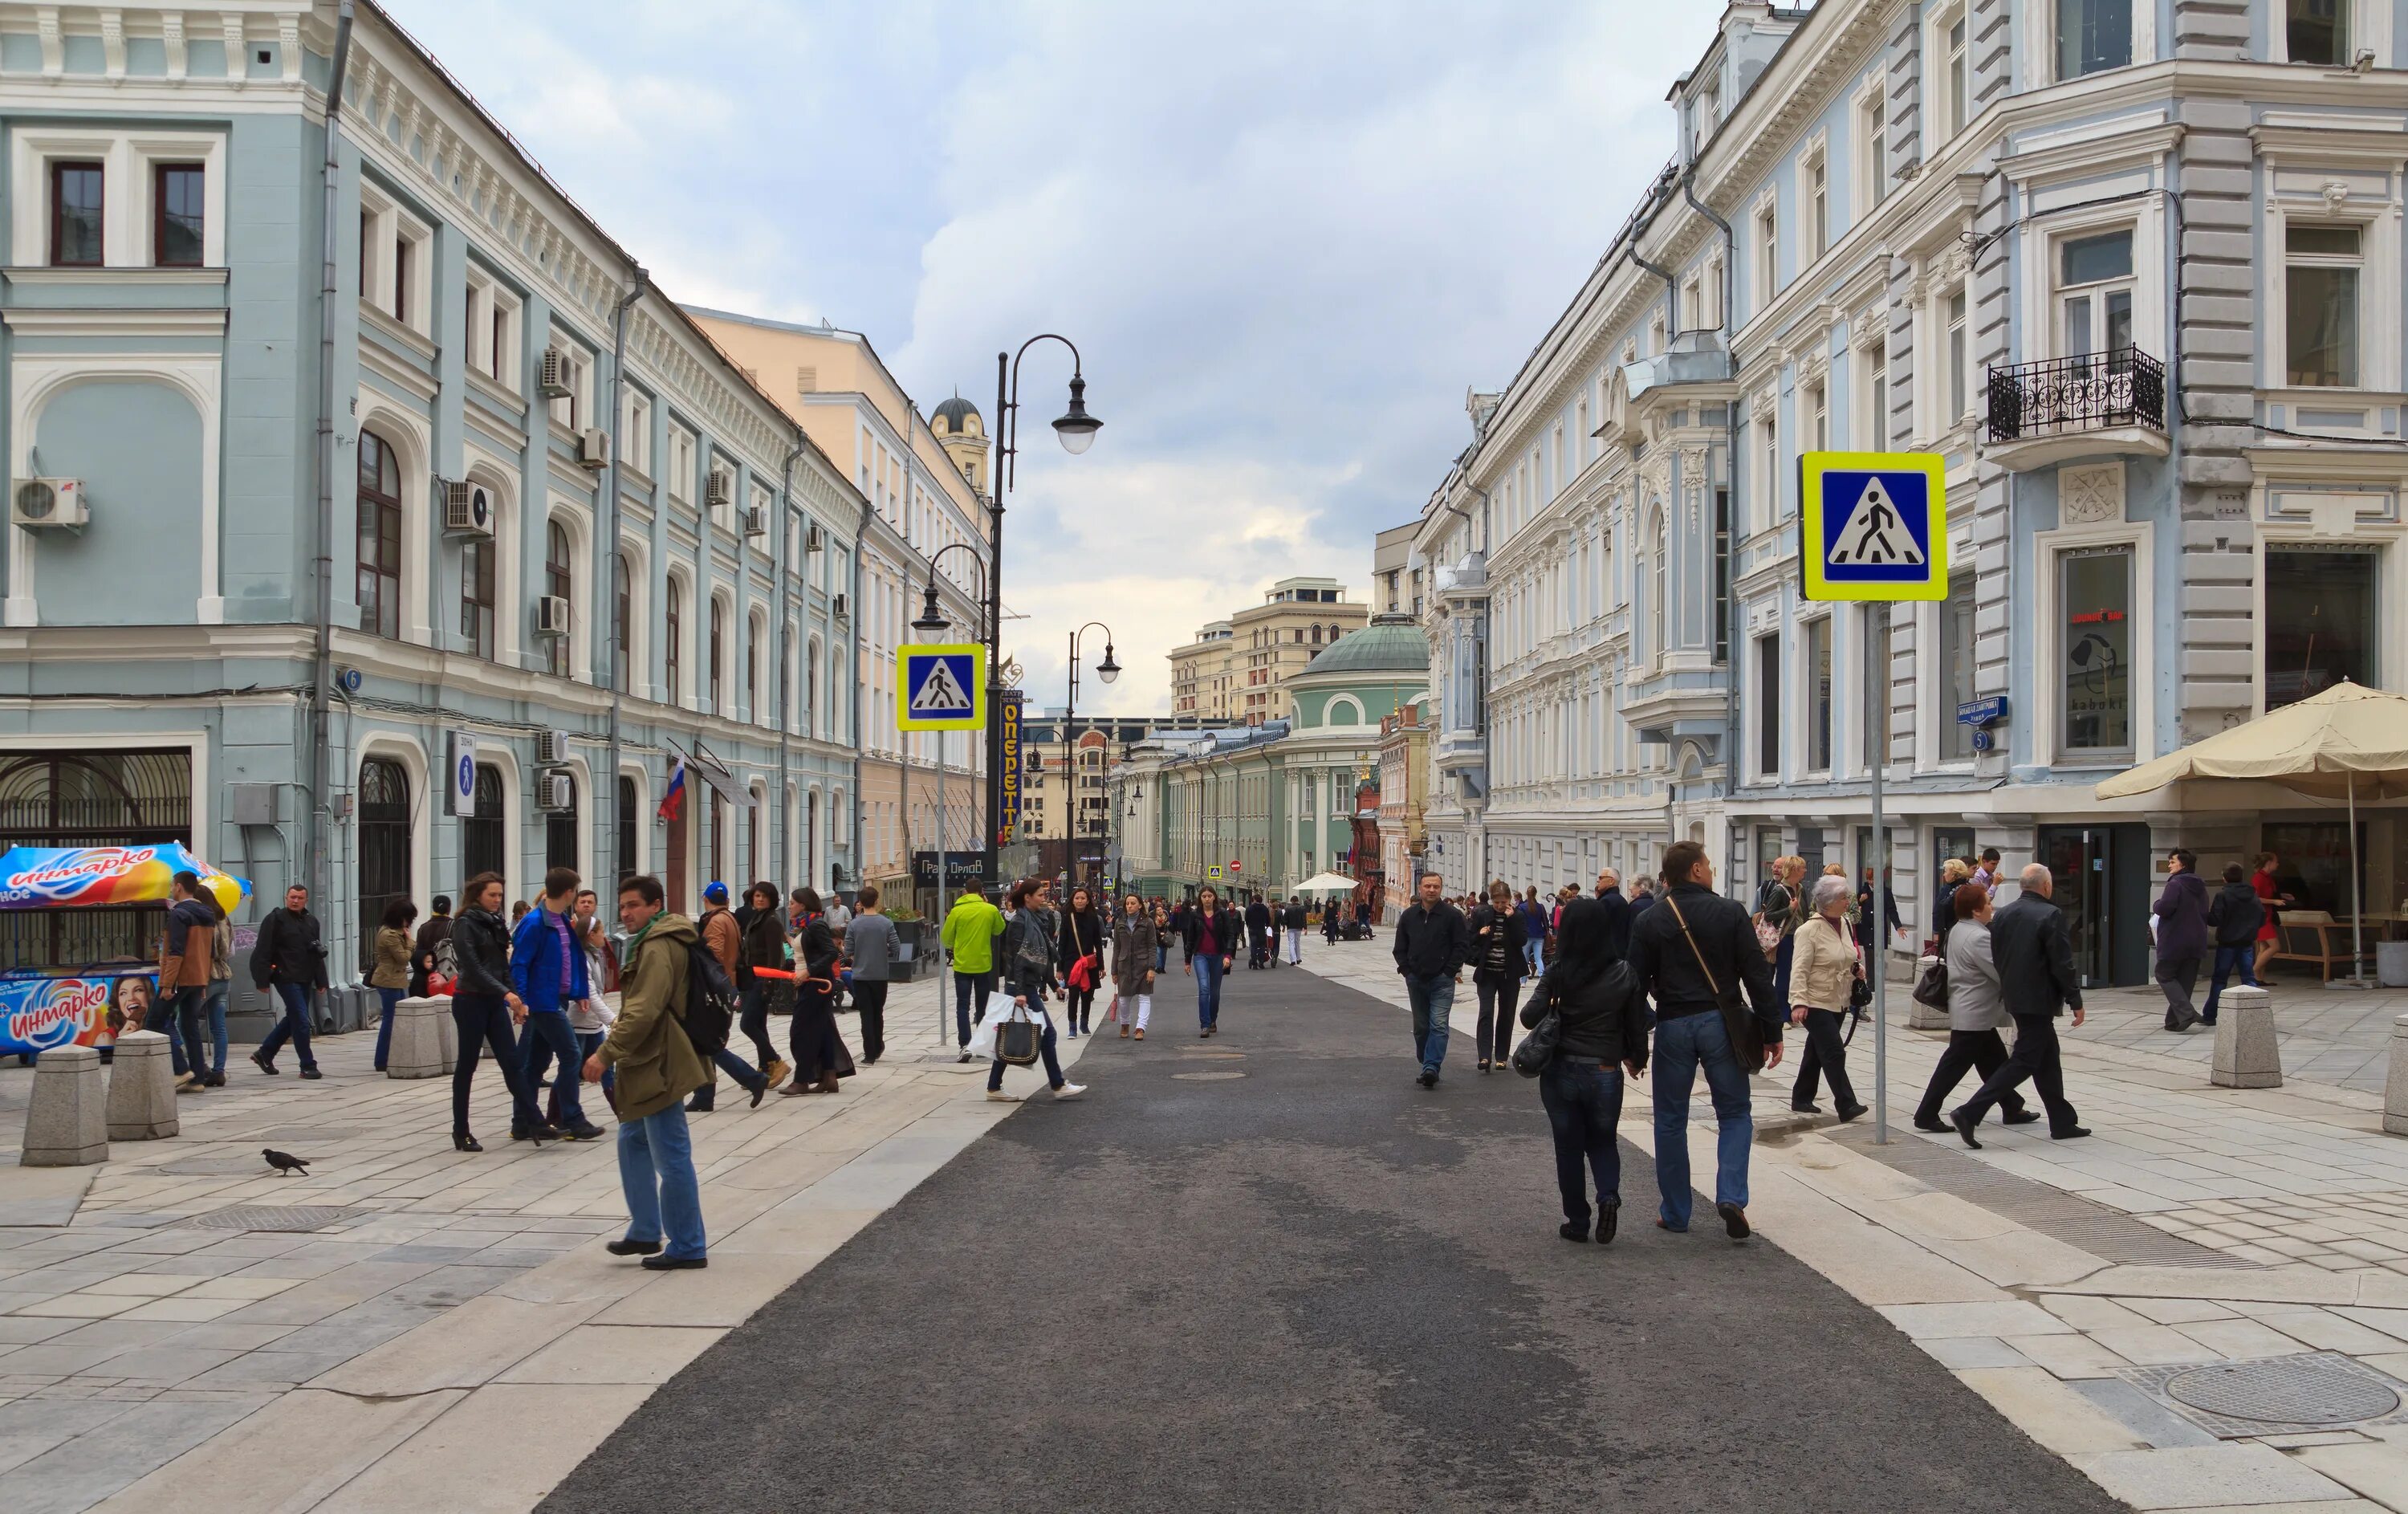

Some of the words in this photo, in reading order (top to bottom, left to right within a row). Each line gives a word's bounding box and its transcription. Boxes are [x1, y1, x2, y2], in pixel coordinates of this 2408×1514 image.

[351, 672, 357, 686] 6
[2072, 697, 2123, 710] kabuki
[461, 736, 472, 747] ЗОНА
[1977, 734, 1982, 747] 5
